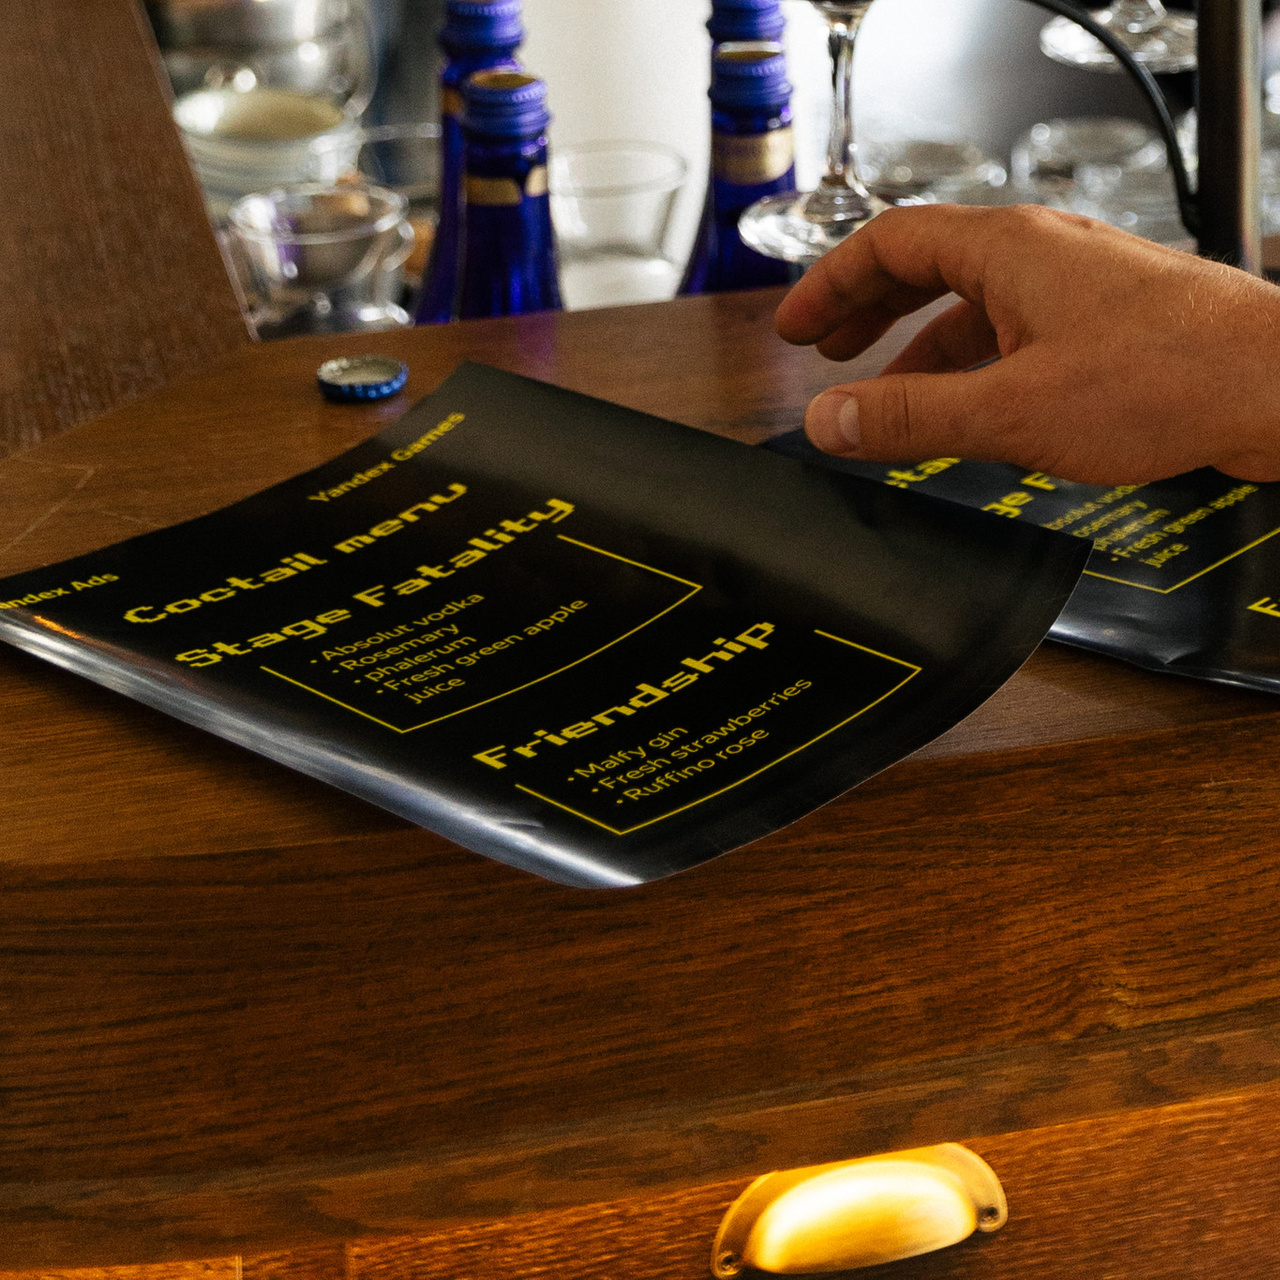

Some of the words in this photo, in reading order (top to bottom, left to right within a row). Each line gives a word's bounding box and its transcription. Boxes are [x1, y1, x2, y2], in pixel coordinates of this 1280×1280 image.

[308, 460, 397, 503] Yandex
[391, 412, 466, 462] Games
[1161, 506, 1216, 535] green
[1207, 483, 1260, 511] apple
[123, 552, 329, 623] Coctail
[333, 483, 468, 554] menu
[174, 609, 352, 668] Stage
[353, 498, 575, 608] Fatality
[0, 587, 72, 610] andex
[70, 573, 120, 592] Ads
[321, 623, 415, 662] Absolut
[413, 593, 486, 627] vodka
[338, 623, 461, 671] Rosemary
[364, 634, 478, 683] phalerum
[383, 661, 456, 691] Fresh
[455, 632, 525, 667] green
[522, 598, 590, 637] apple
[403, 676, 467, 705] juice
[472, 621, 777, 771] Friendship
[573, 740, 649, 779] Malfy
[647, 724, 690, 751] gin
[597, 754, 673, 790] Fresh
[669, 676, 814, 761] strawberries
[622, 758, 717, 802] Ruffino
[714, 725, 771, 762] rose
